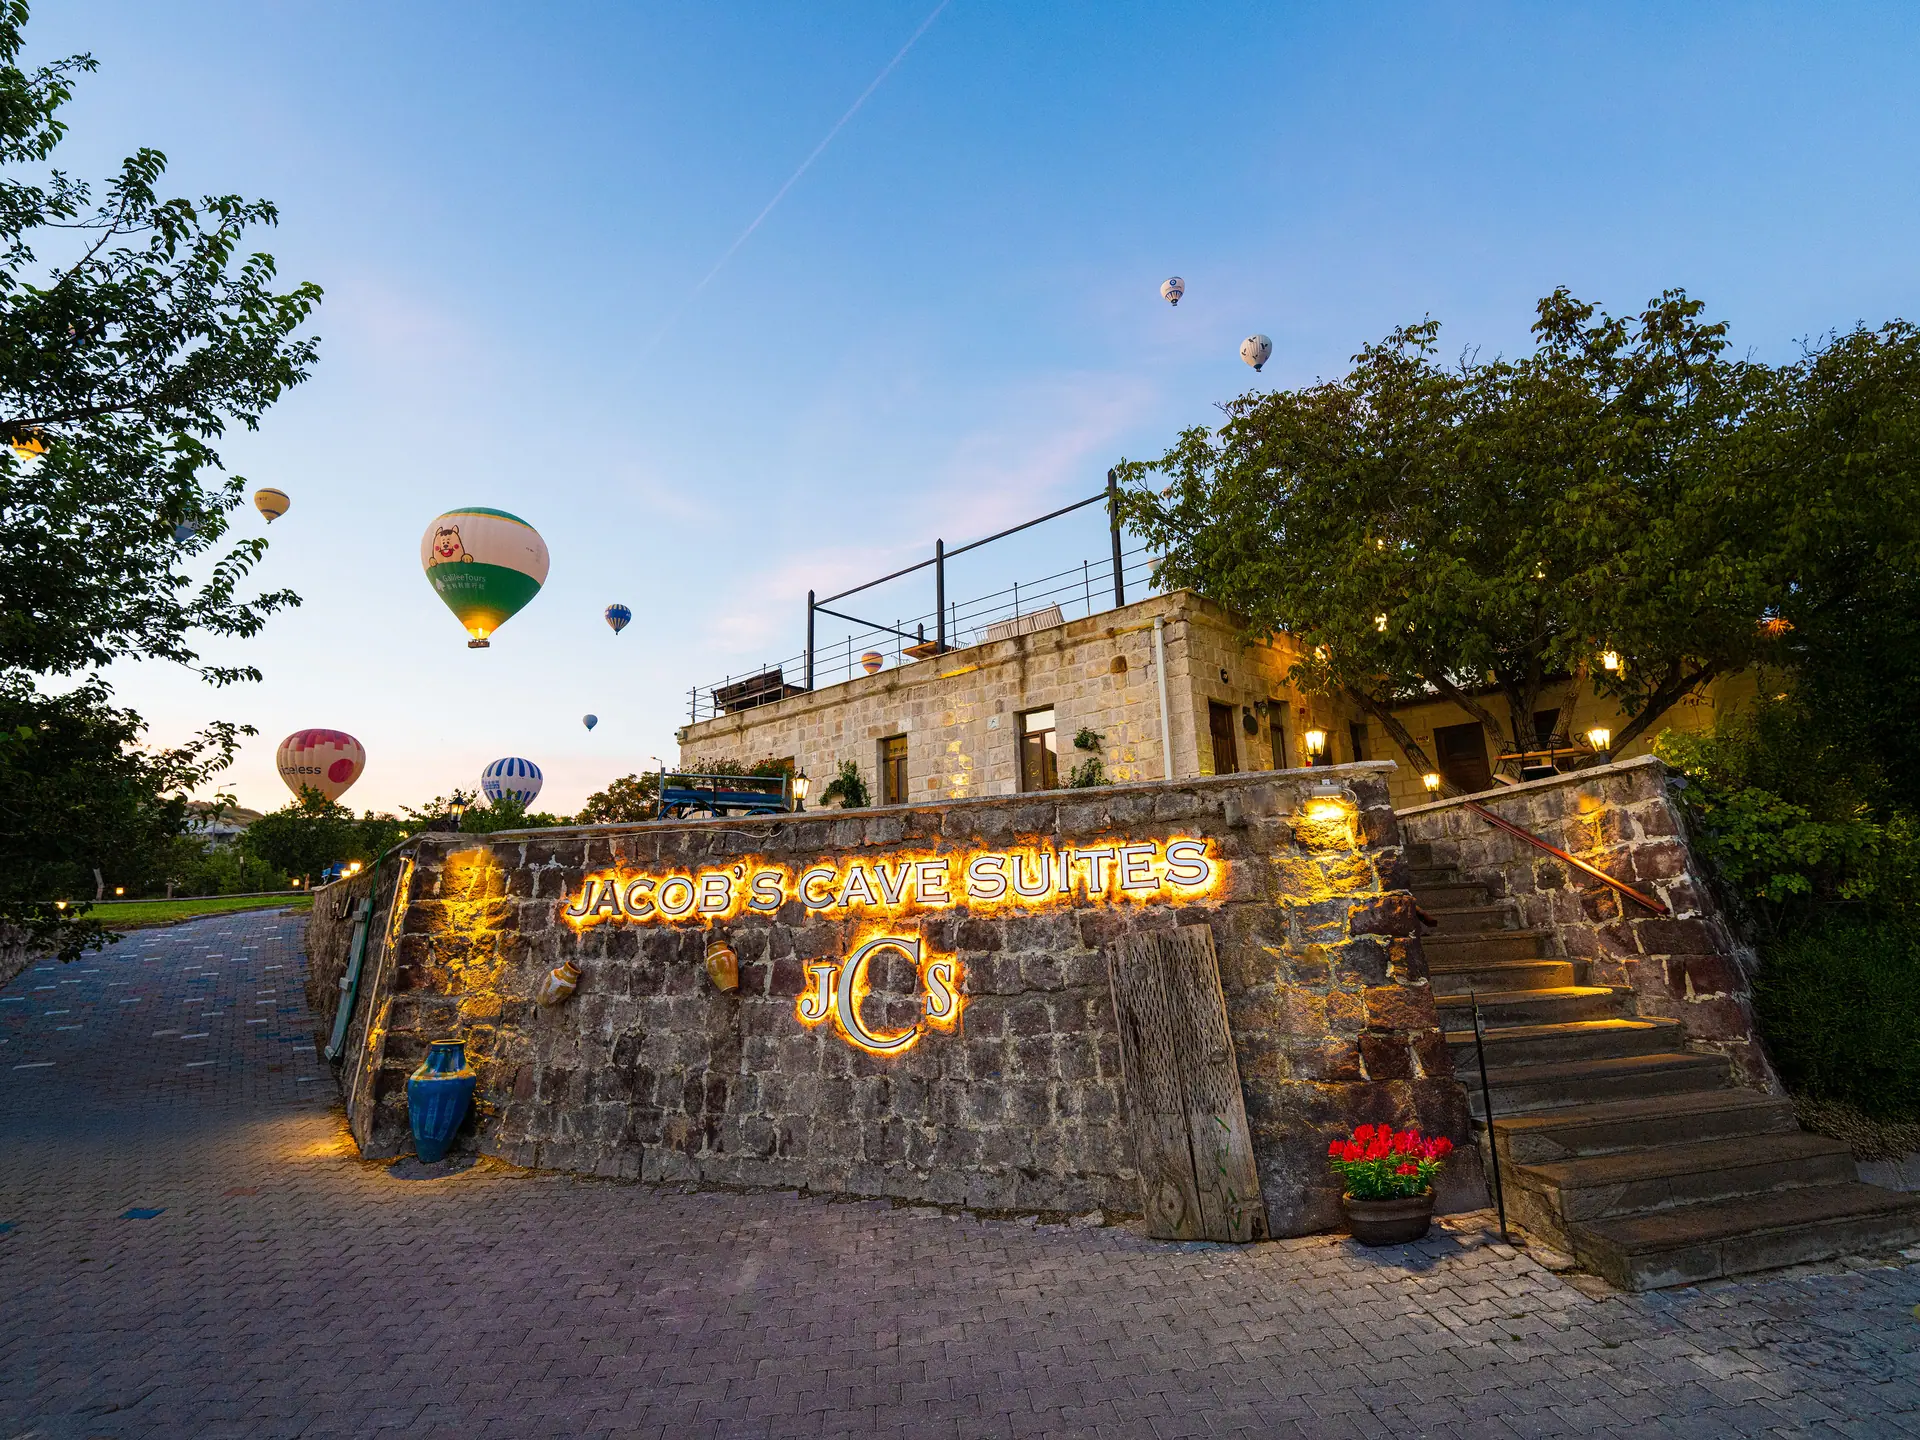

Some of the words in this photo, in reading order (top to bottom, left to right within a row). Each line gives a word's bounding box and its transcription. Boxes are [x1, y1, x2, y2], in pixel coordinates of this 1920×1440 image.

[566, 865, 784, 917] JACOB'S
[798, 861, 949, 910] CAVE
[967, 840, 1210, 899] SUITES
[801, 937, 952, 1050] JCS
